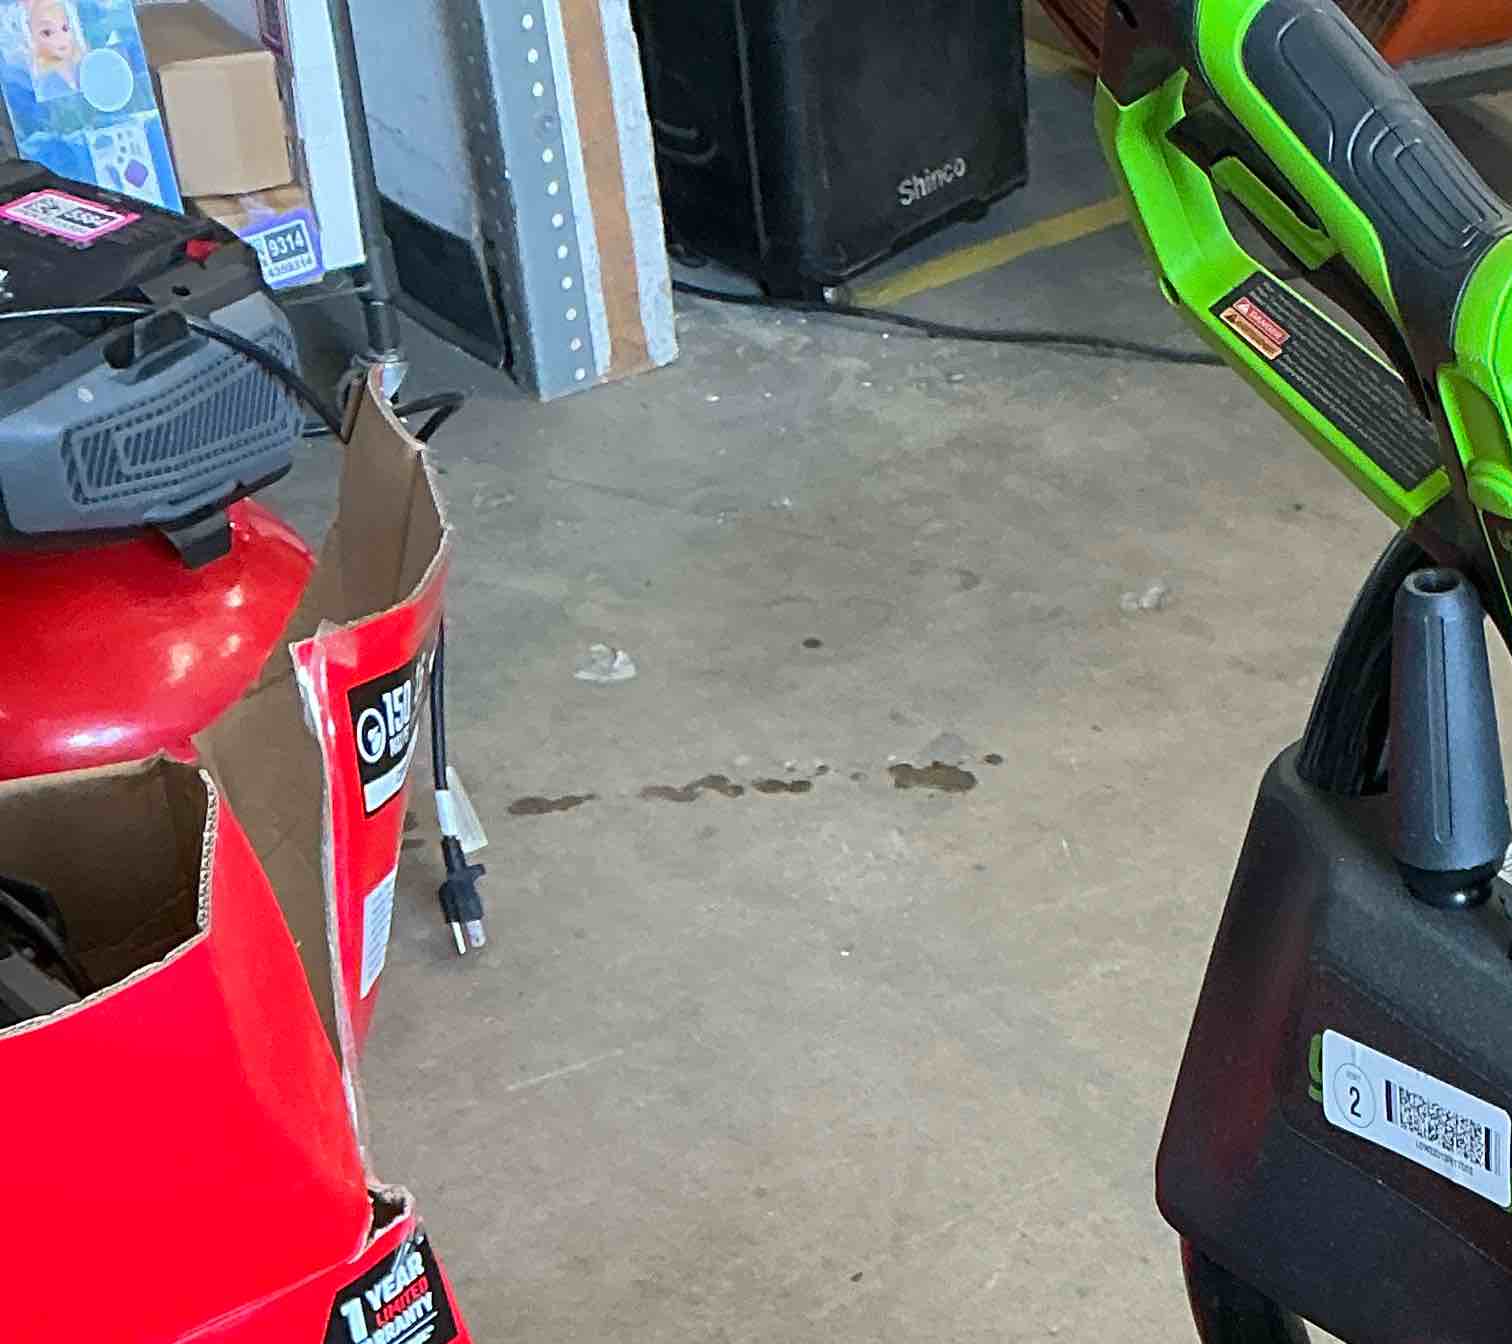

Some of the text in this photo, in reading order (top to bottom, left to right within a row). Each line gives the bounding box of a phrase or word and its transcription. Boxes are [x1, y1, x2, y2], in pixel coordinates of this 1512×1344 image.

[898, 157, 966, 206] Shinco
[1349, 1086, 1361, 1118] 2
[340, 1251, 425, 1344] 1 YEAR
[375, 1276, 429, 1328] LIMITED
